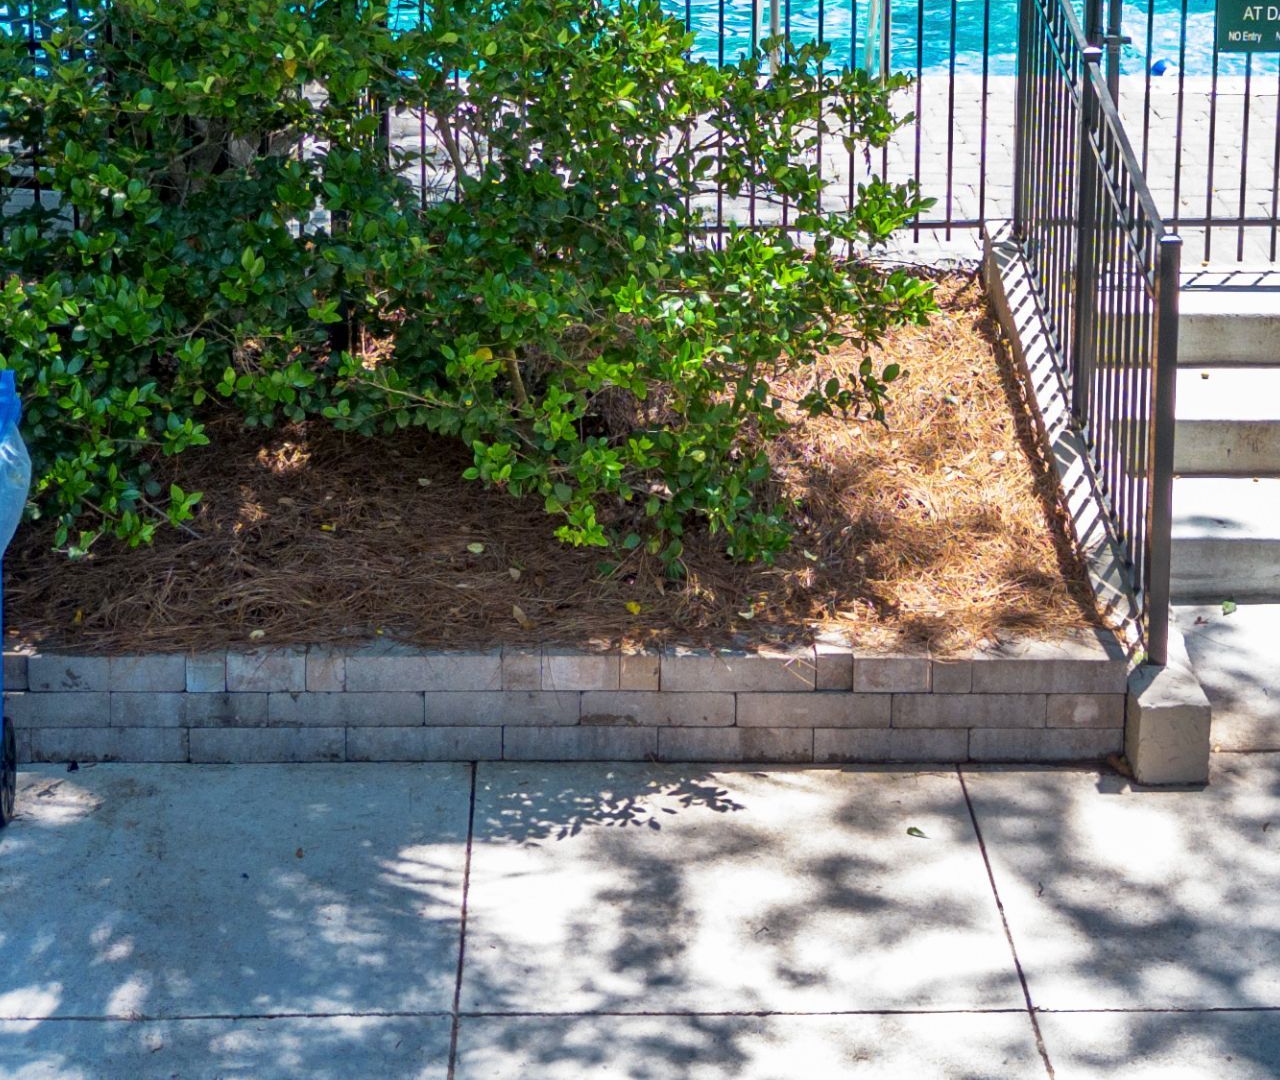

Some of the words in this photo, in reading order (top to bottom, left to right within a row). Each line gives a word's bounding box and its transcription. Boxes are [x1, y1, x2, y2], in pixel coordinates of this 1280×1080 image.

[1242, 6, 1264, 21] AT
[1228, 31, 1241, 41] NO
[1242, 31, 1263, 43] Entry
